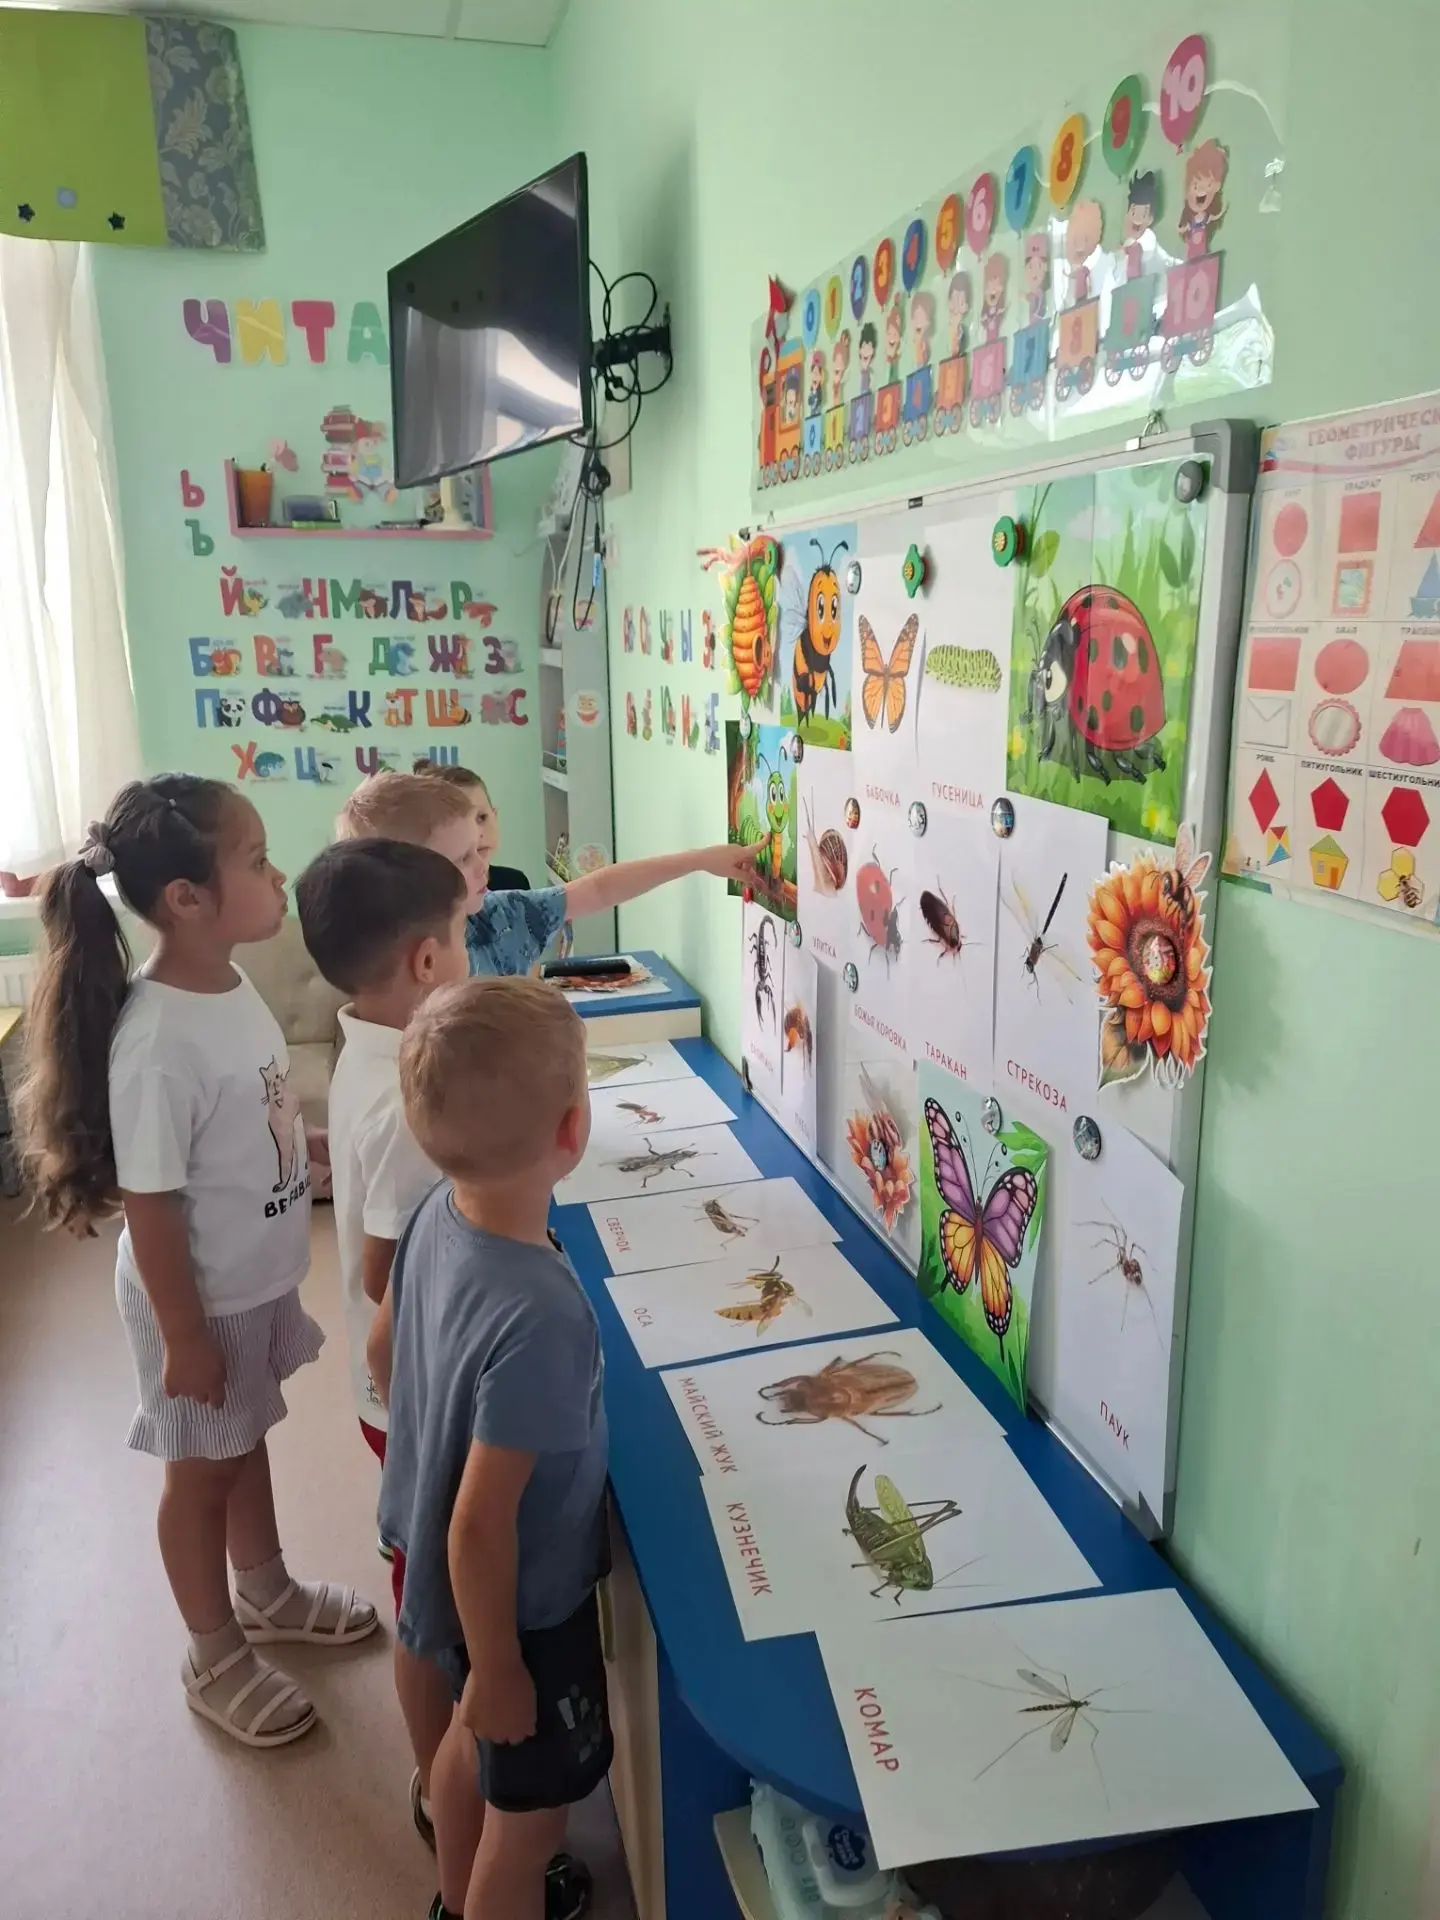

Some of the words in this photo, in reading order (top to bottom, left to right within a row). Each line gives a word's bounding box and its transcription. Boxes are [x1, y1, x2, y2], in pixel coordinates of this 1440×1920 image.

[806, 300, 814, 332] 0
[829, 287, 837, 320] 1
[853, 265, 864, 295] 2
[878, 265, 887, 293] 3
[907, 232, 919, 271] 4
[941, 208, 953, 250] 5
[972, 187, 986, 232] 6
[1013, 163, 1027, 211] 7
[1059, 132, 1074, 182] 8
[1112, 95, 1131, 149] 9
[1166, 54, 1205, 121] 10
[856, 408, 864, 432] 2
[882, 393, 891, 422] 3
[1024, 336, 1036, 374] 7
[1172, 270, 1210, 326] 10
[1344, 433, 1421, 460] ФИГУРЫ
[329, 578, 364, 619] М
[189, 637, 214, 677] Б
[348, 690, 373, 729] К
[1300, 760, 1363, 776] ПЯТИУГОЛЬНИК
[866, 784, 901, 808] БАБОЧКА
[931, 781, 984, 809] ГУСЕНИЦА
[875, 1017, 908, 1053] КОРОВКА
[924, 1041, 968, 1081] ТАРАКАН
[1006, 1059, 1068, 1113] СТРЕКОЗА
[633, 1306, 654, 1328] ОСА
[679, 1376, 724, 1441] МАЙСКИЙ
[710, 1443, 738, 1475] ЖУК
[1100, 1400, 1130, 1452] ПАУК
[726, 1502, 773, 1597] КУЗНЕЧИК
[854, 1687, 900, 1772] КОМАР
